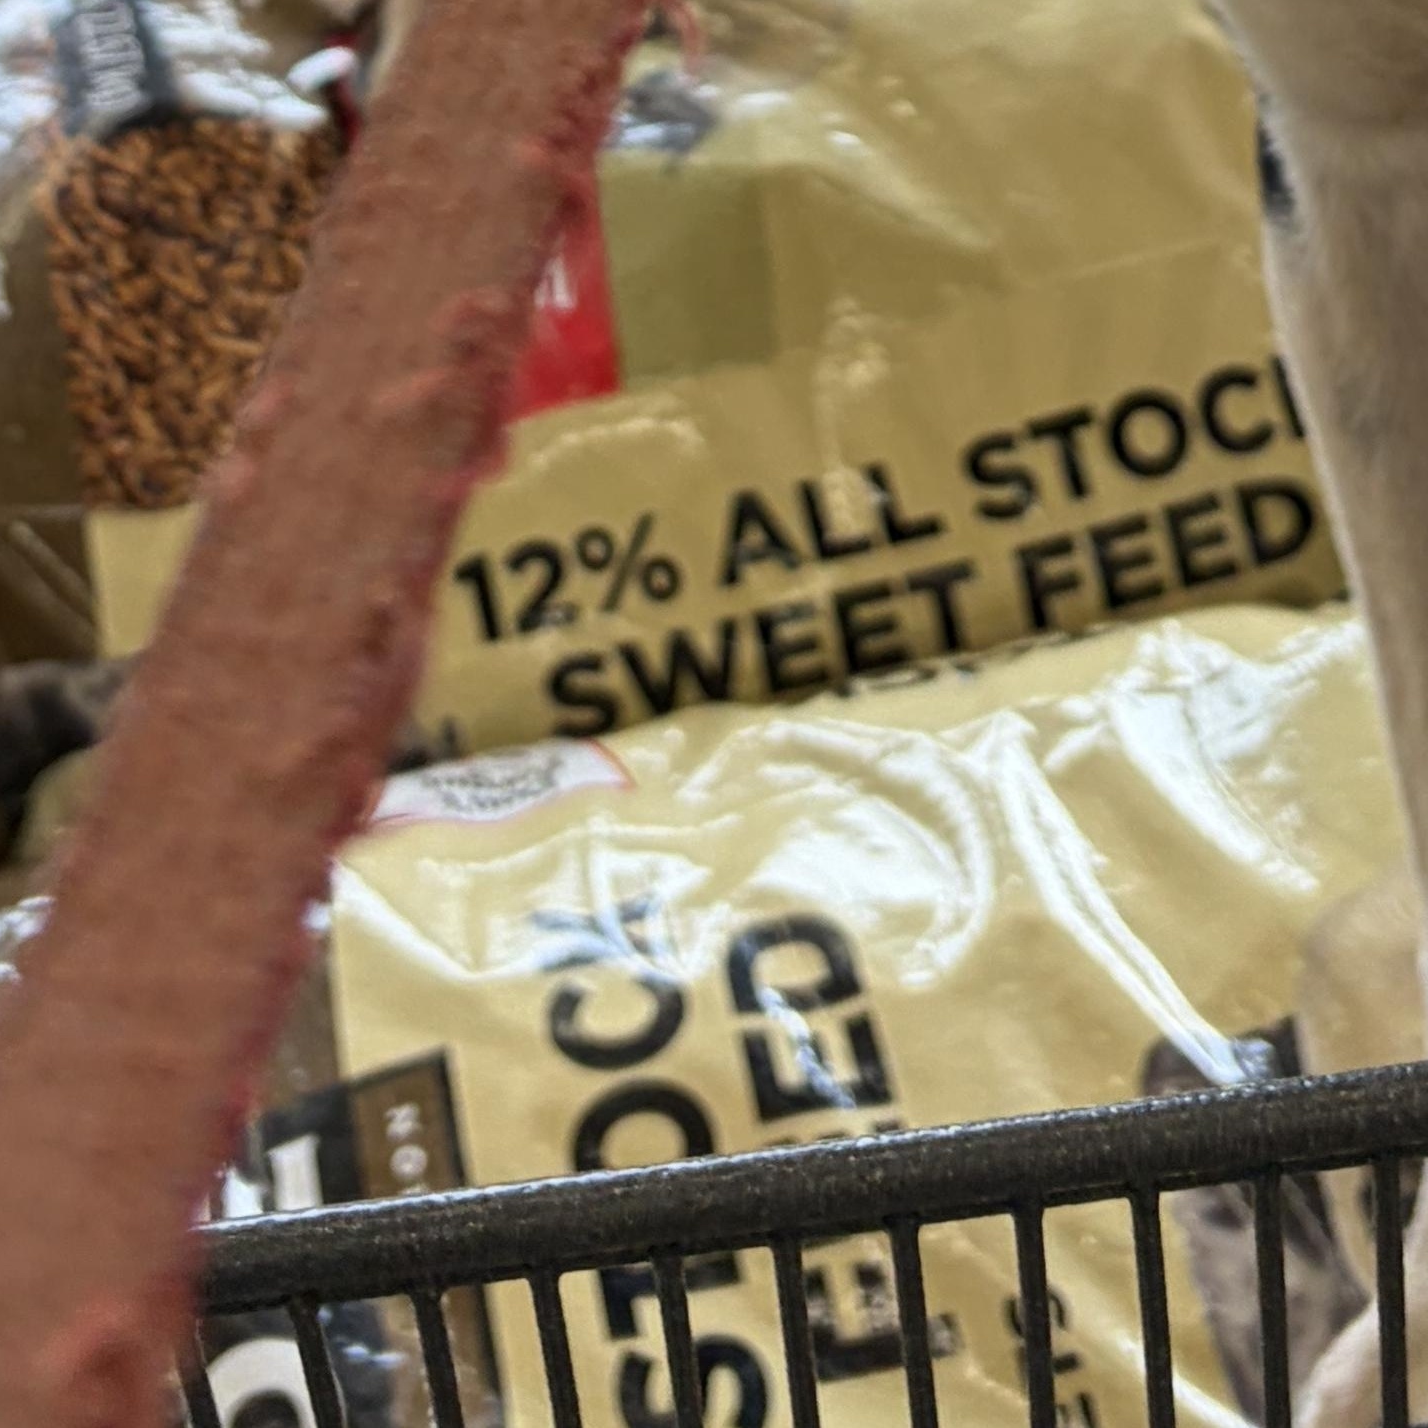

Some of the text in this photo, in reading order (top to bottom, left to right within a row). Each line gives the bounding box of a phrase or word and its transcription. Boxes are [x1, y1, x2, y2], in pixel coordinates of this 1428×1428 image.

[454, 512, 684, 643] 12%
[717, 460, 943, 587] ALL
[546, 476, 1314, 738] SWEET FEED
